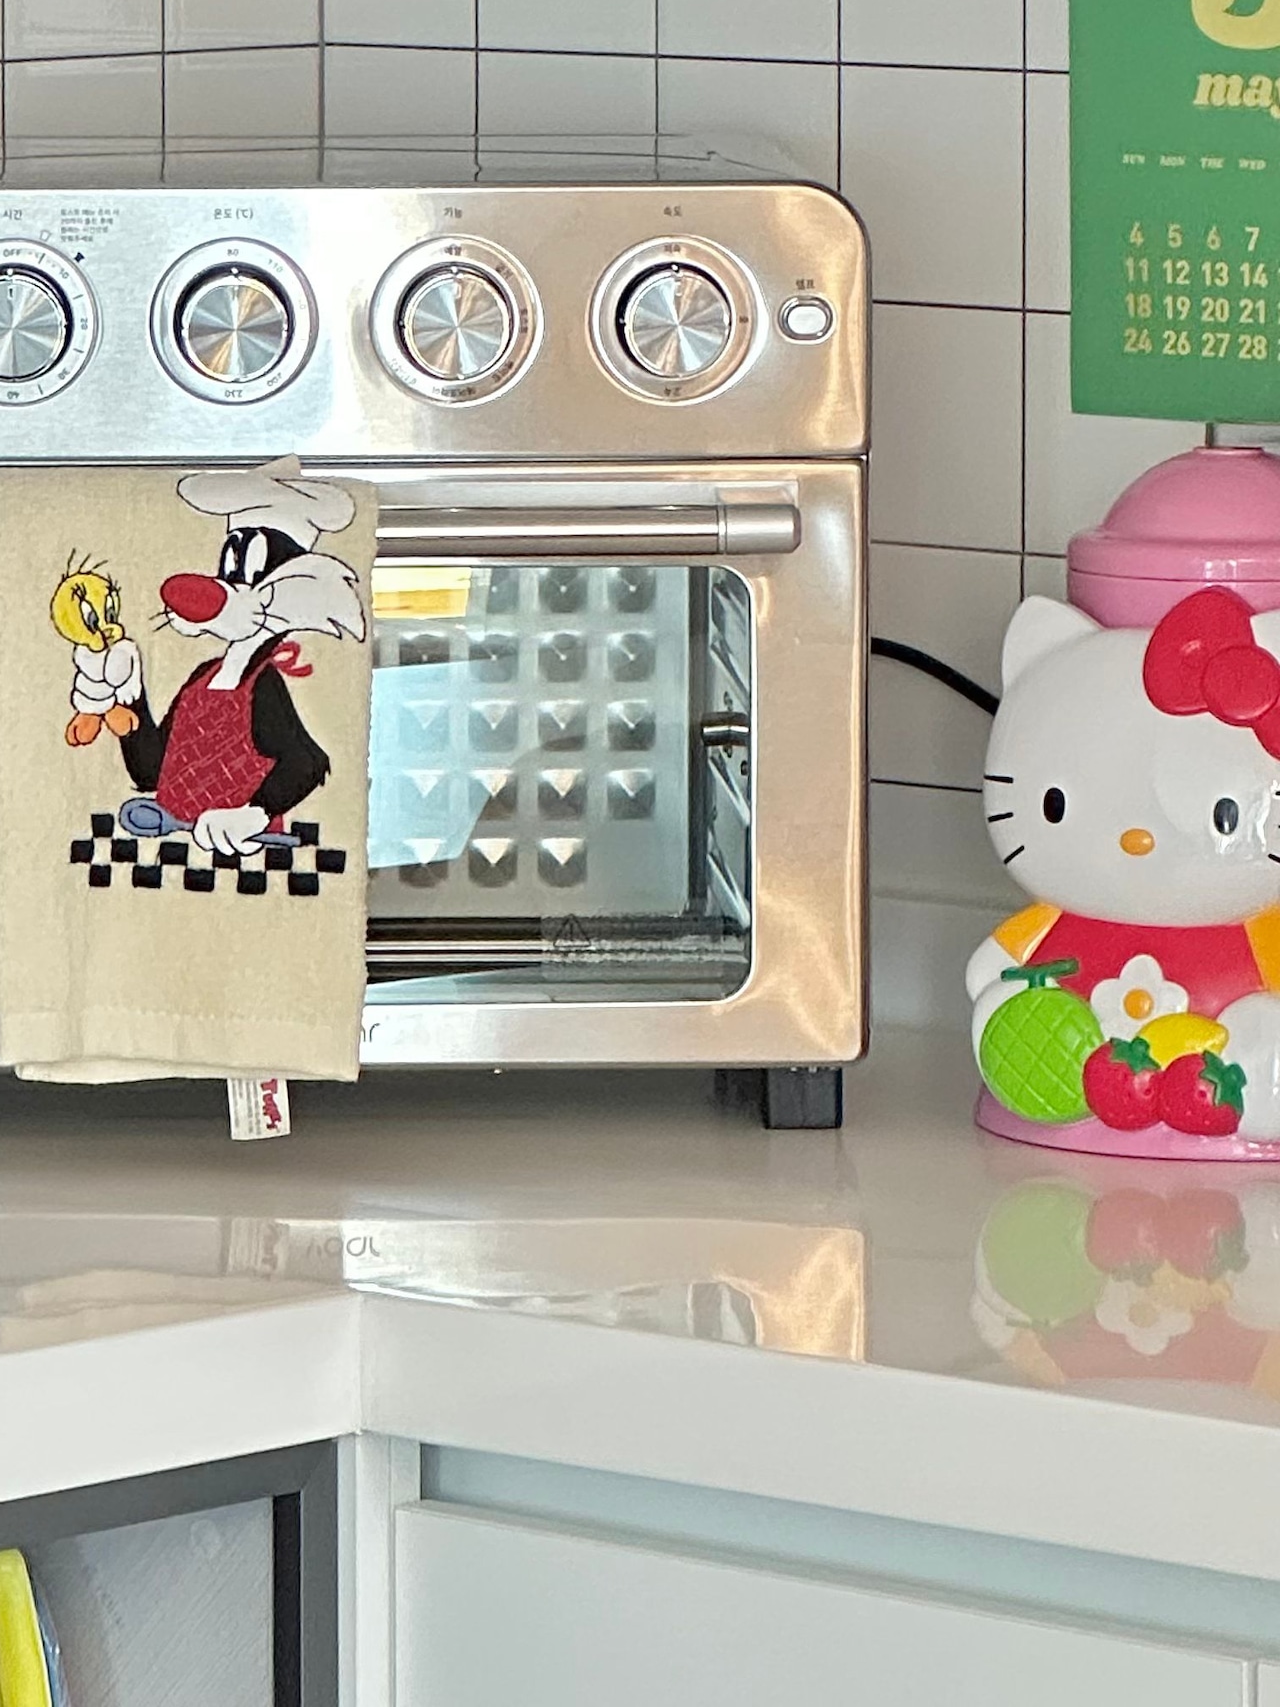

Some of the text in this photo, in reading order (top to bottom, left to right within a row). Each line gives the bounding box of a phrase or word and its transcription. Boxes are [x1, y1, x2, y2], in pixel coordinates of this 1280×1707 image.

[3, 209, 23, 221] 시간
[214, 208, 232, 220] 온도
[1129, 221, 1261, 252] 4 5 6 7
[3, 248, 21, 257] OFF
[1125, 257, 1269, 288] 11 12 13 14
[1125, 293, 1267, 324] 18 19 20 21
[1163, 330, 1191, 356] 26
[1201, 332, 1231, 359] 27
[1238, 334, 1269, 361] 28
